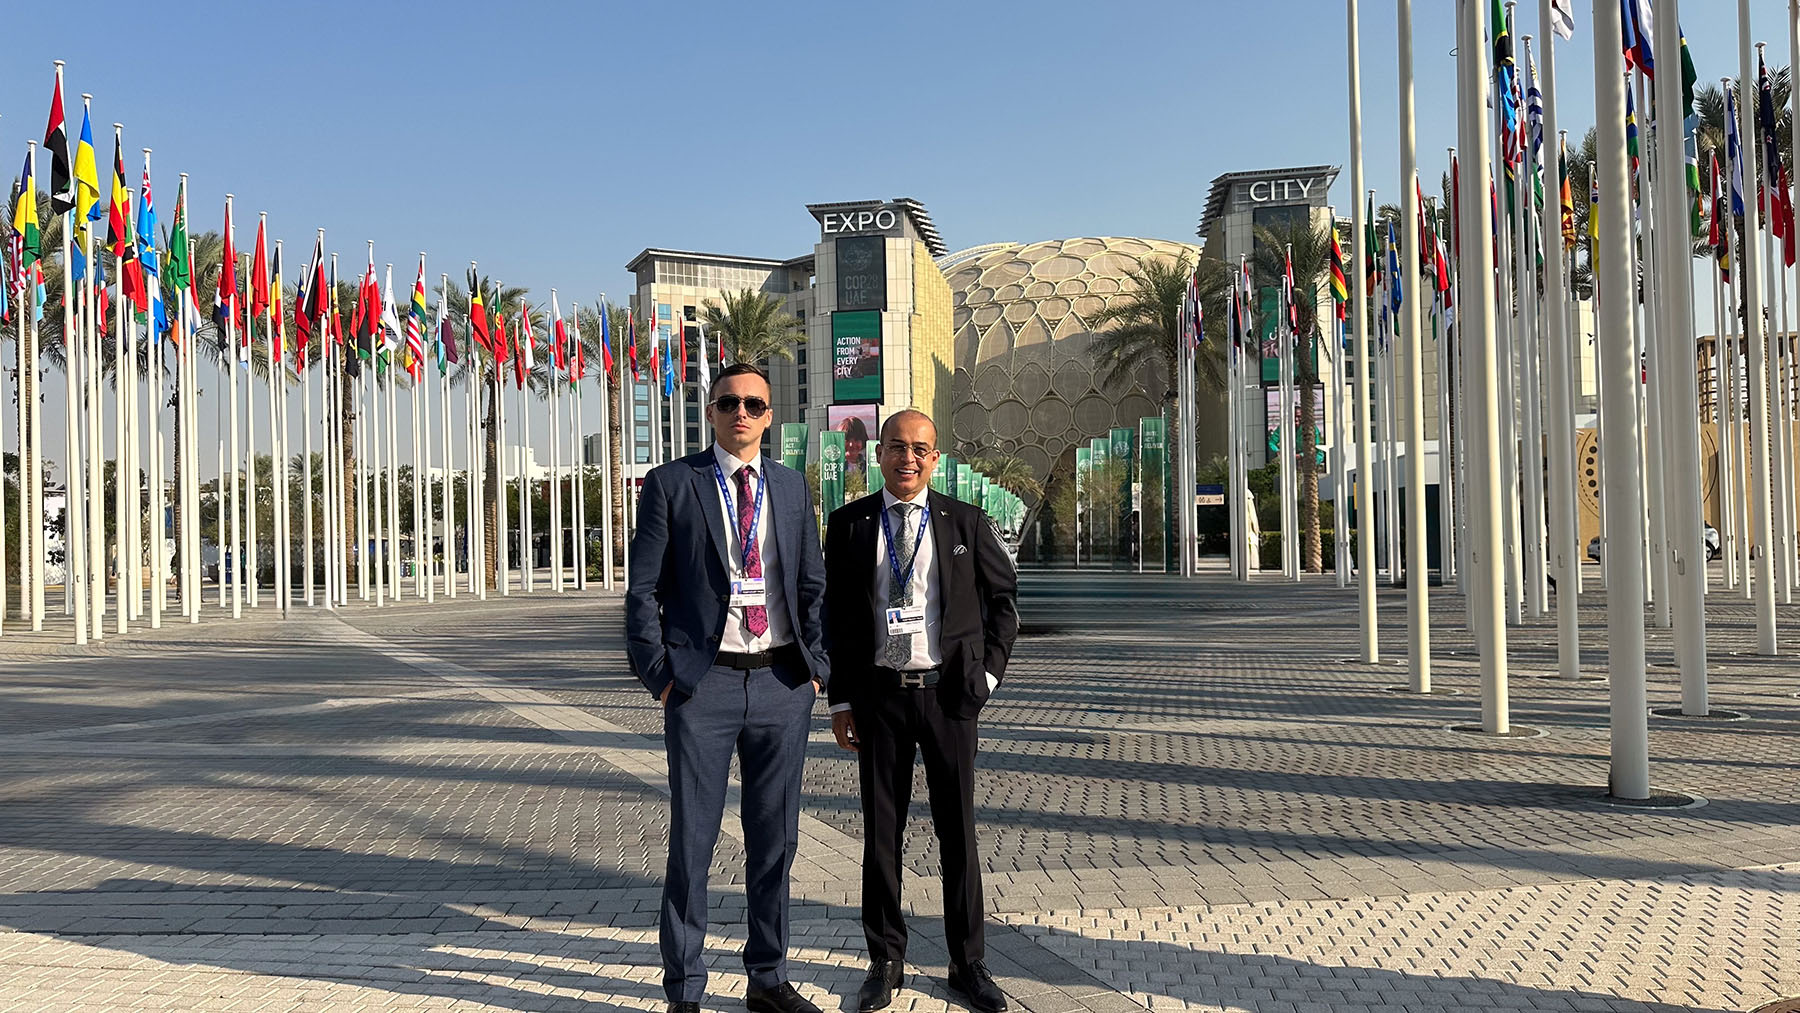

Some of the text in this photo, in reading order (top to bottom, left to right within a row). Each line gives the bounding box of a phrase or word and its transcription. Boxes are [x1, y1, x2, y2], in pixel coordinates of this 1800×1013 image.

[1249, 177, 1315, 202] CITY
[823, 209, 896, 233] EXPO
[845, 274, 878, 290] COP28
[845, 290, 867, 305] UAE
[836, 336, 861, 346] ACTION
[836, 346, 855, 356] FROM
[836, 356, 858, 366] EVERY
[836, 366, 852, 376] CITY
[824, 463, 844, 471] COP28
[824, 472, 838, 480] UAE
